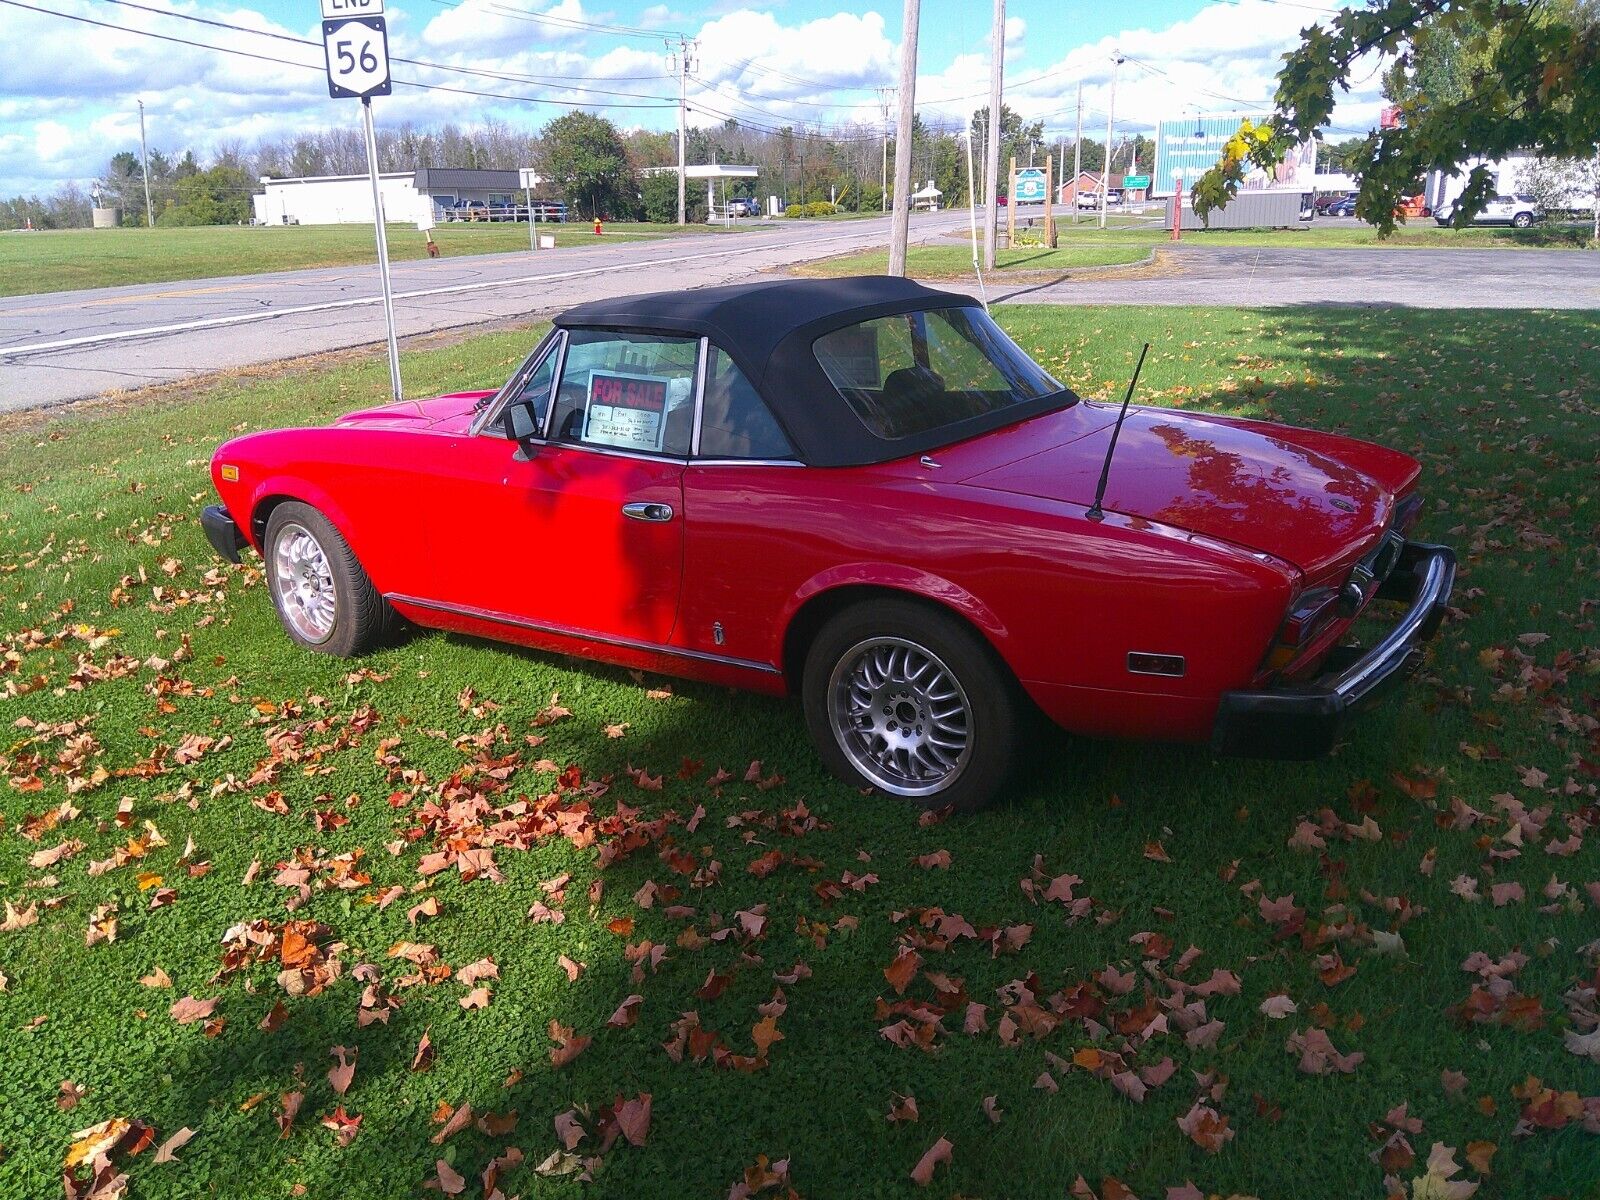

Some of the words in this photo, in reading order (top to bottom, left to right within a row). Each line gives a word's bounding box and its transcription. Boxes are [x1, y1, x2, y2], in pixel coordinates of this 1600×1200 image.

[337, 40, 377, 74] 56
[592, 378, 622, 404] FOR
[626, 382, 664, 409] SALE
